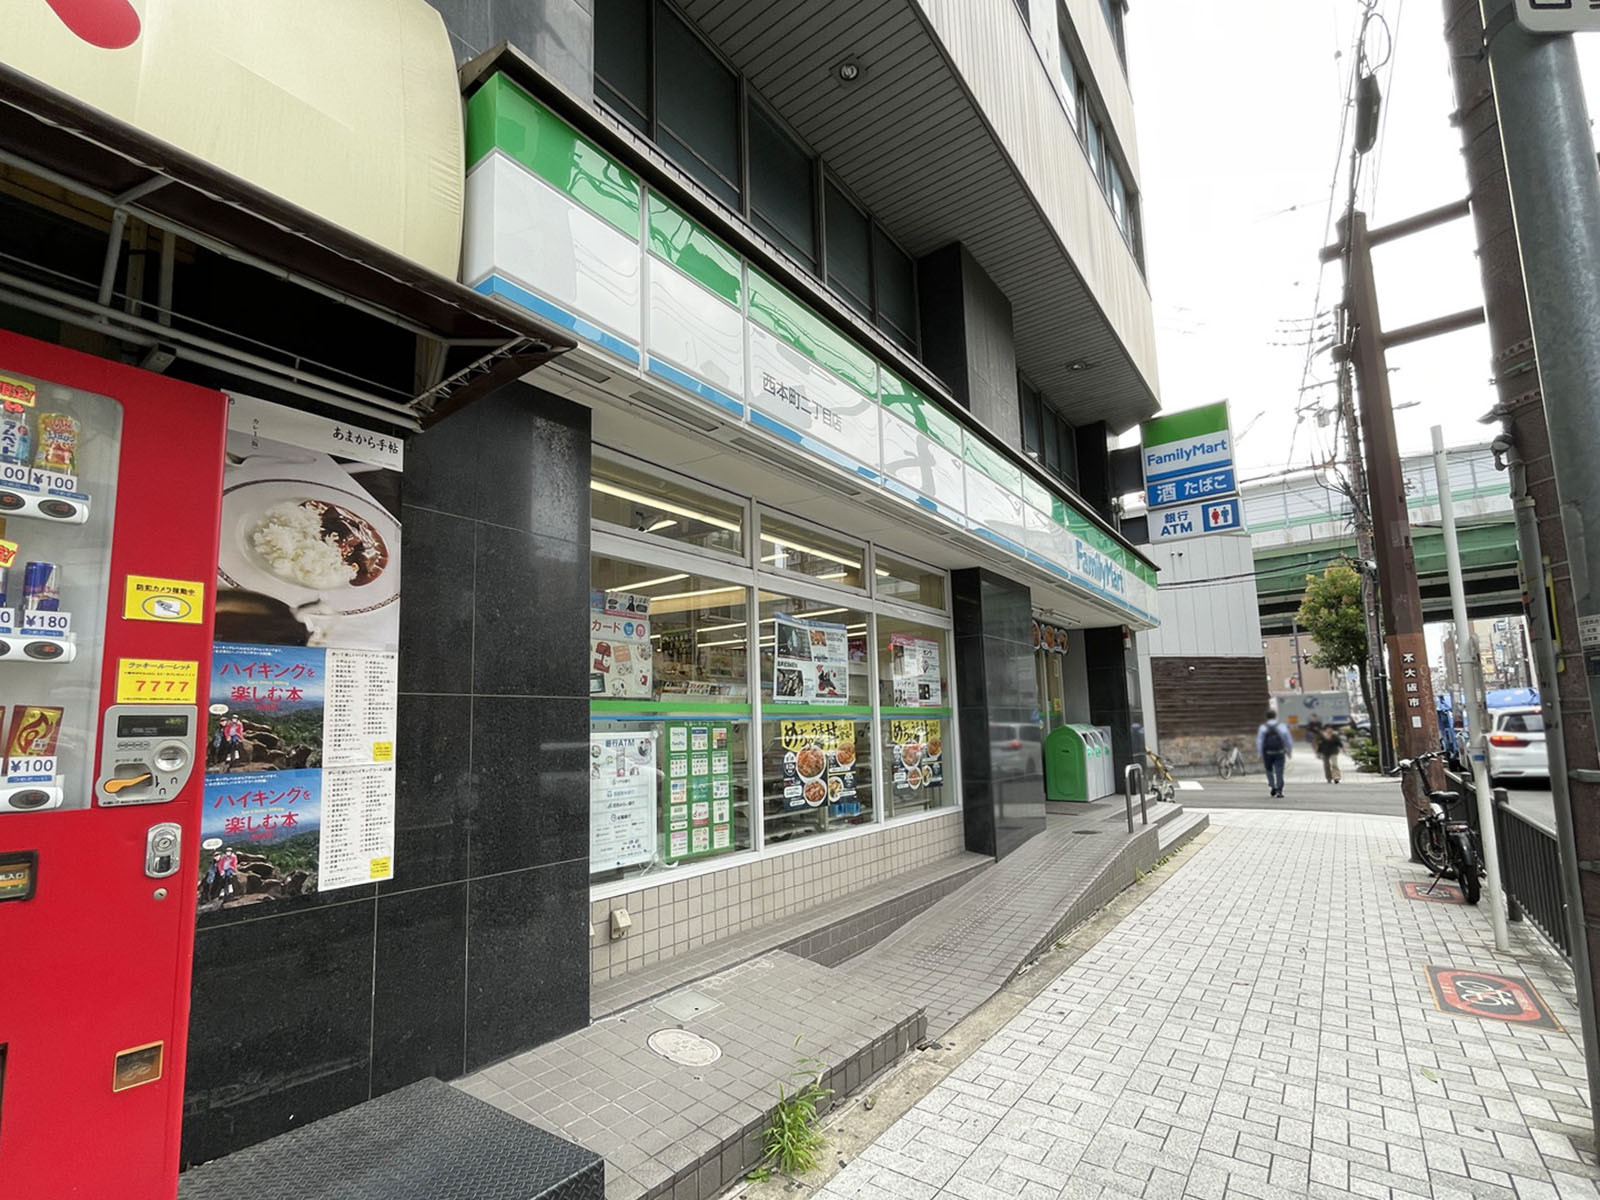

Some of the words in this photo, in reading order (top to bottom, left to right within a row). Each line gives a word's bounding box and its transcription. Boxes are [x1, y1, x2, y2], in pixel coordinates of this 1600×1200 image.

[762, 372, 842, 432] 西本町二丁目店
[332, 426, 399, 454] あまから手帖
[1147, 439, 1227, 467] FamilyMart
[33, 472, 74, 491] ¥100
[1157, 483, 1177, 503] 酒
[1184, 474, 1228, 496] たばこ
[1164, 510, 1189, 524] 銀行
[1160, 522, 1193, 536] ATM
[1075, 539, 1125, 594] FamilyMart
[26, 614, 68, 628] ¥180
[592, 619, 622, 634] カード
[219, 661, 316, 681] ハイキングを
[231, 686, 304, 703] 楽しむ本
[10, 759, 53, 773] ¥100
[213, 786, 311, 809] ハイキングを
[224, 811, 299, 835] 楽しむ本
